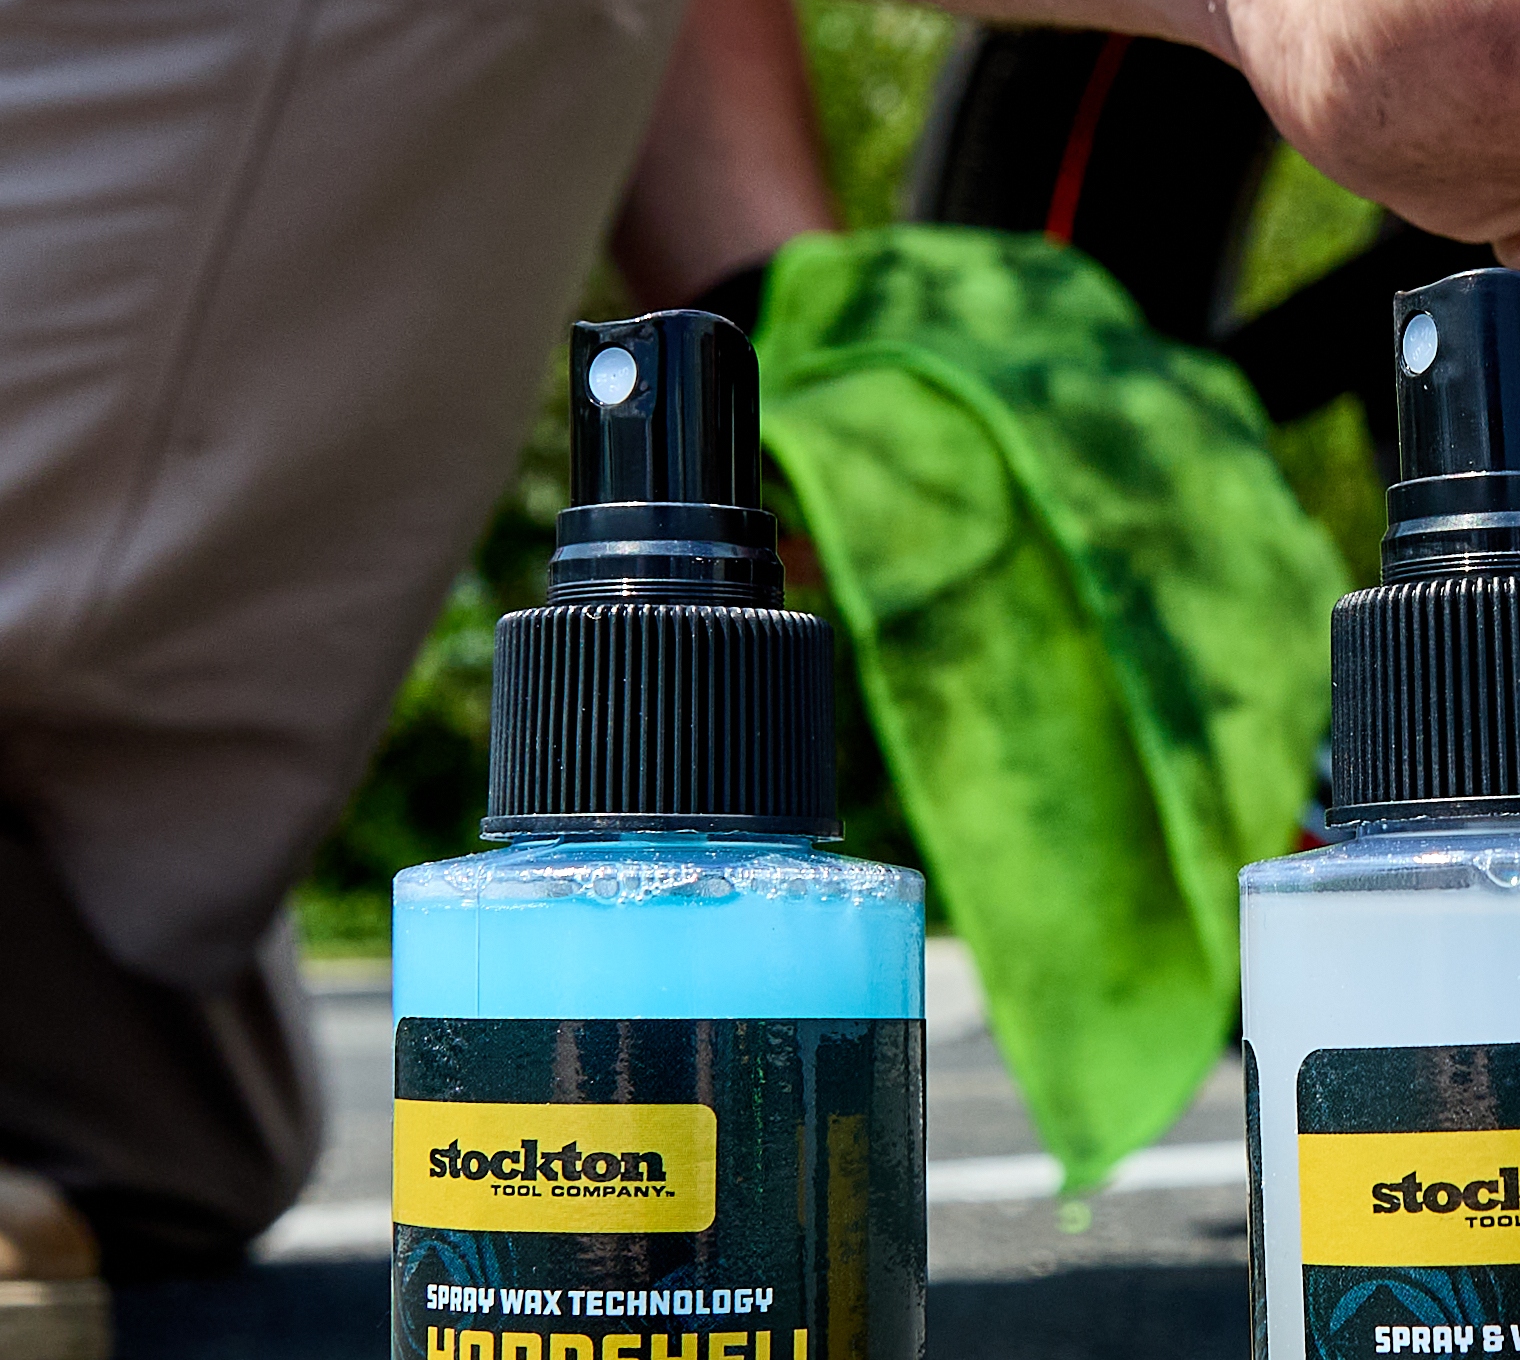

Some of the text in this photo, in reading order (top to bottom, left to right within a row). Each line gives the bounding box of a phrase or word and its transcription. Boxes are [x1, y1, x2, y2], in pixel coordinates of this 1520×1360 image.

[429, 1138, 667, 1182] stockton
[491, 1185, 541, 1197] TOOL
[426, 1284, 773, 1316] SPRAY WAX TECHNOLOGY
[1375, 1324, 1474, 1354] SPRAY
[1482, 1324, 1504, 1352] &
